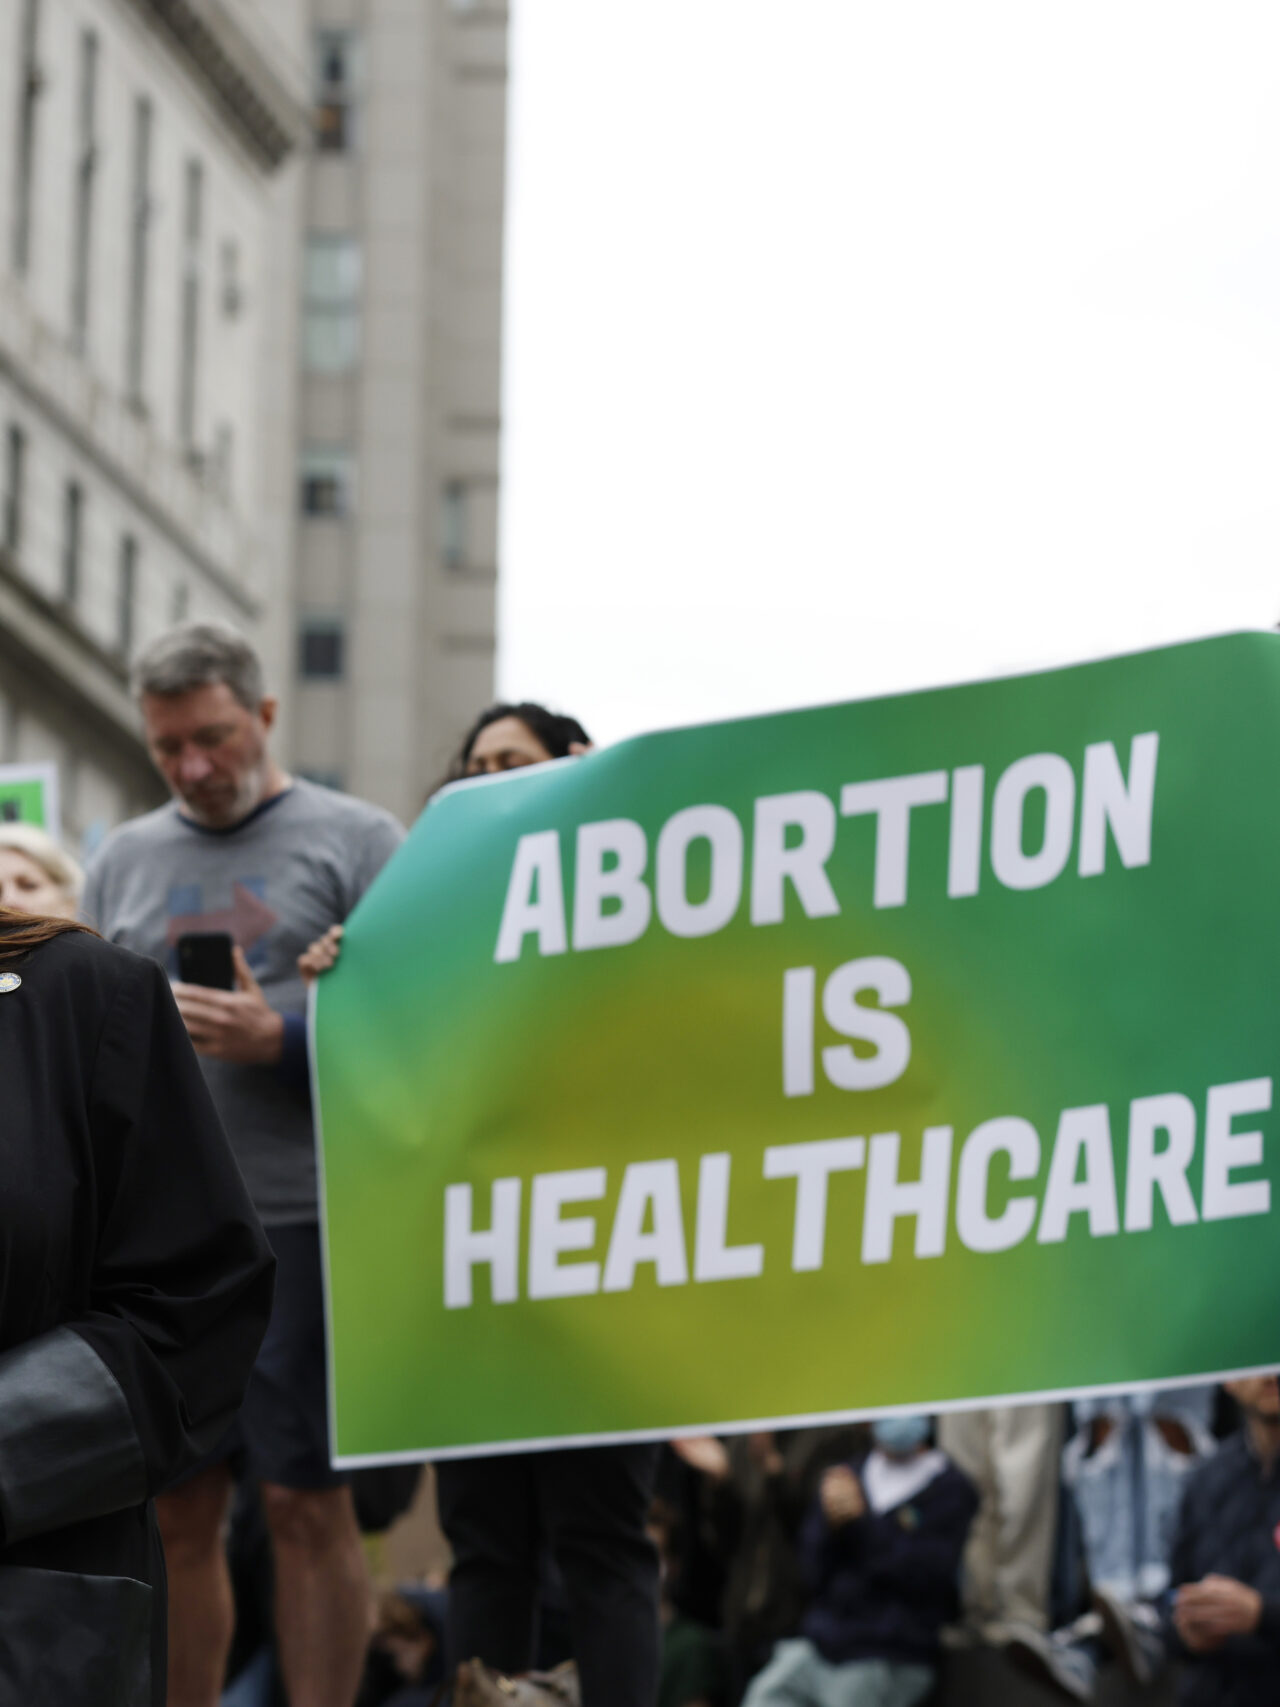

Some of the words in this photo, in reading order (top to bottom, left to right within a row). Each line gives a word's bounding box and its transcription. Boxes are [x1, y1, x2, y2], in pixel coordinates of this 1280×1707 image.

[494, 731, 1158, 964] ABORTION
[783, 956, 912, 1098] IS
[443, 1077, 1273, 1310] HEALTHCARE
